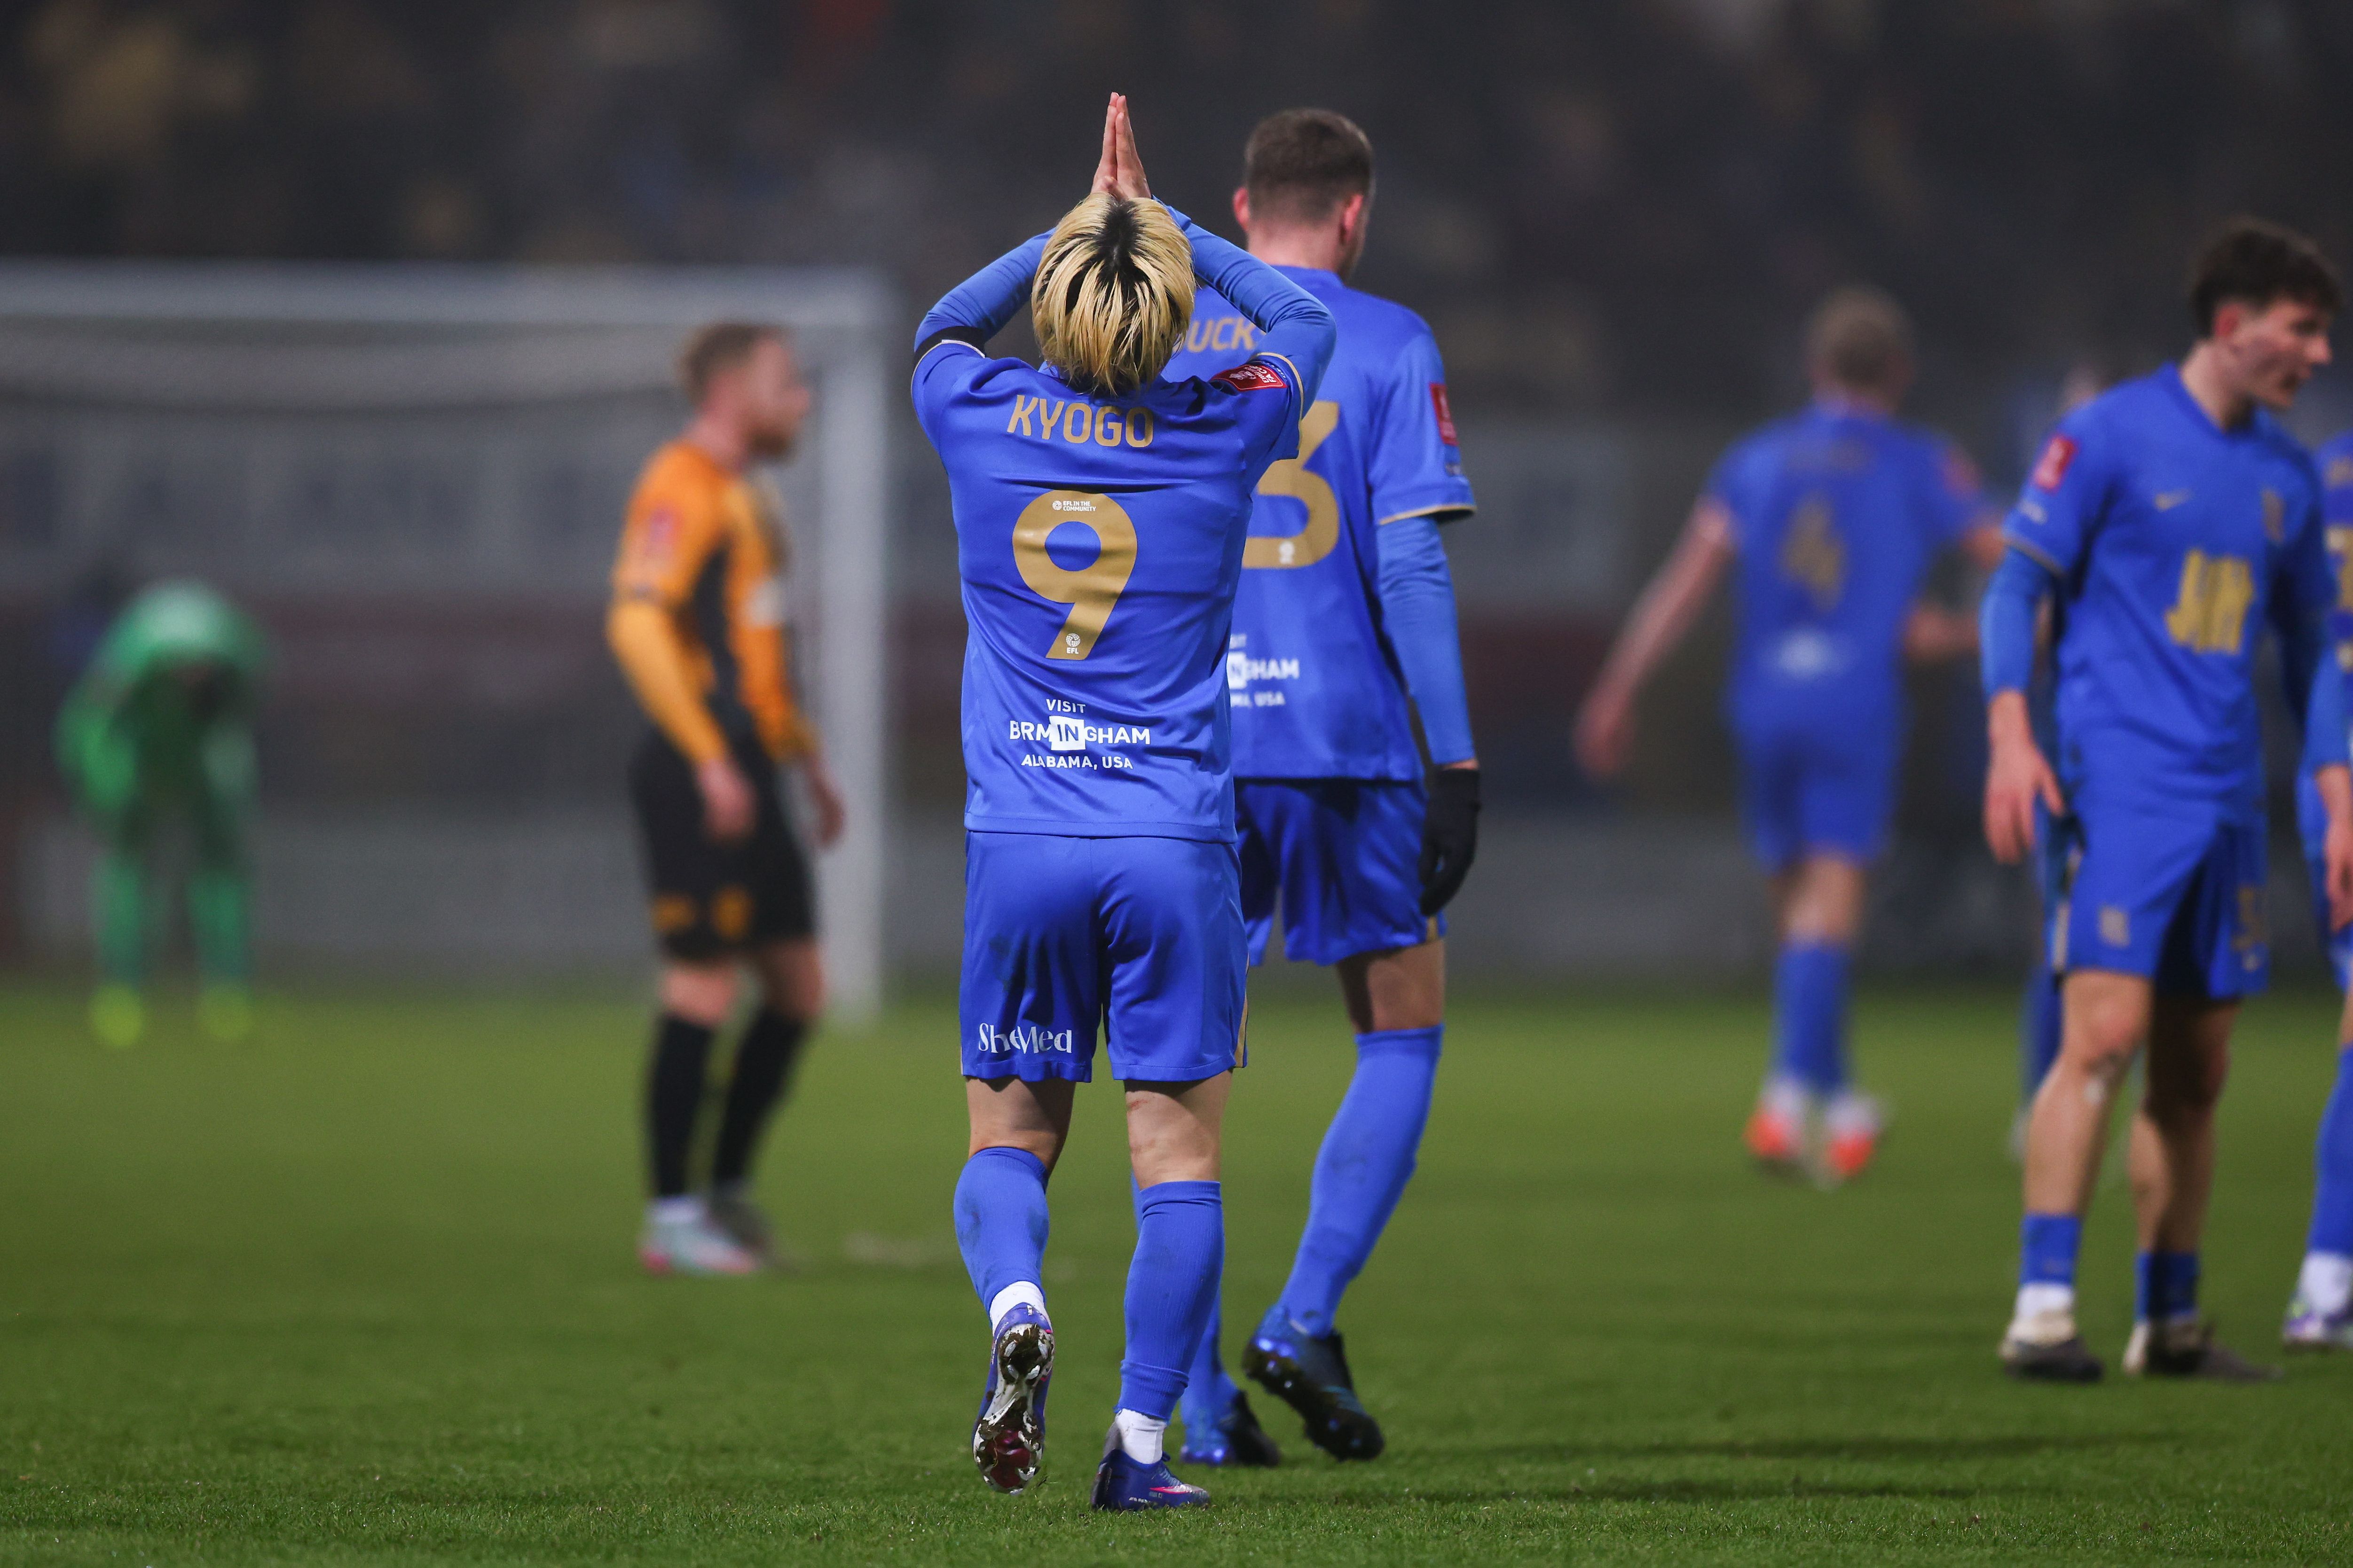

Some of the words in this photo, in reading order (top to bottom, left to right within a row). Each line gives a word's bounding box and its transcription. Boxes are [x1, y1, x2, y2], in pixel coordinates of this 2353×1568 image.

[1007, 394, 1154, 448] KYOGO
[1012, 489, 1138, 660] 9
[1046, 698, 1086, 713] VISIT
[1021, 754, 1098, 770] ALABAMA,
[1102, 756, 1133, 769] USA
[978, 1022, 1072, 1054] SheMed
